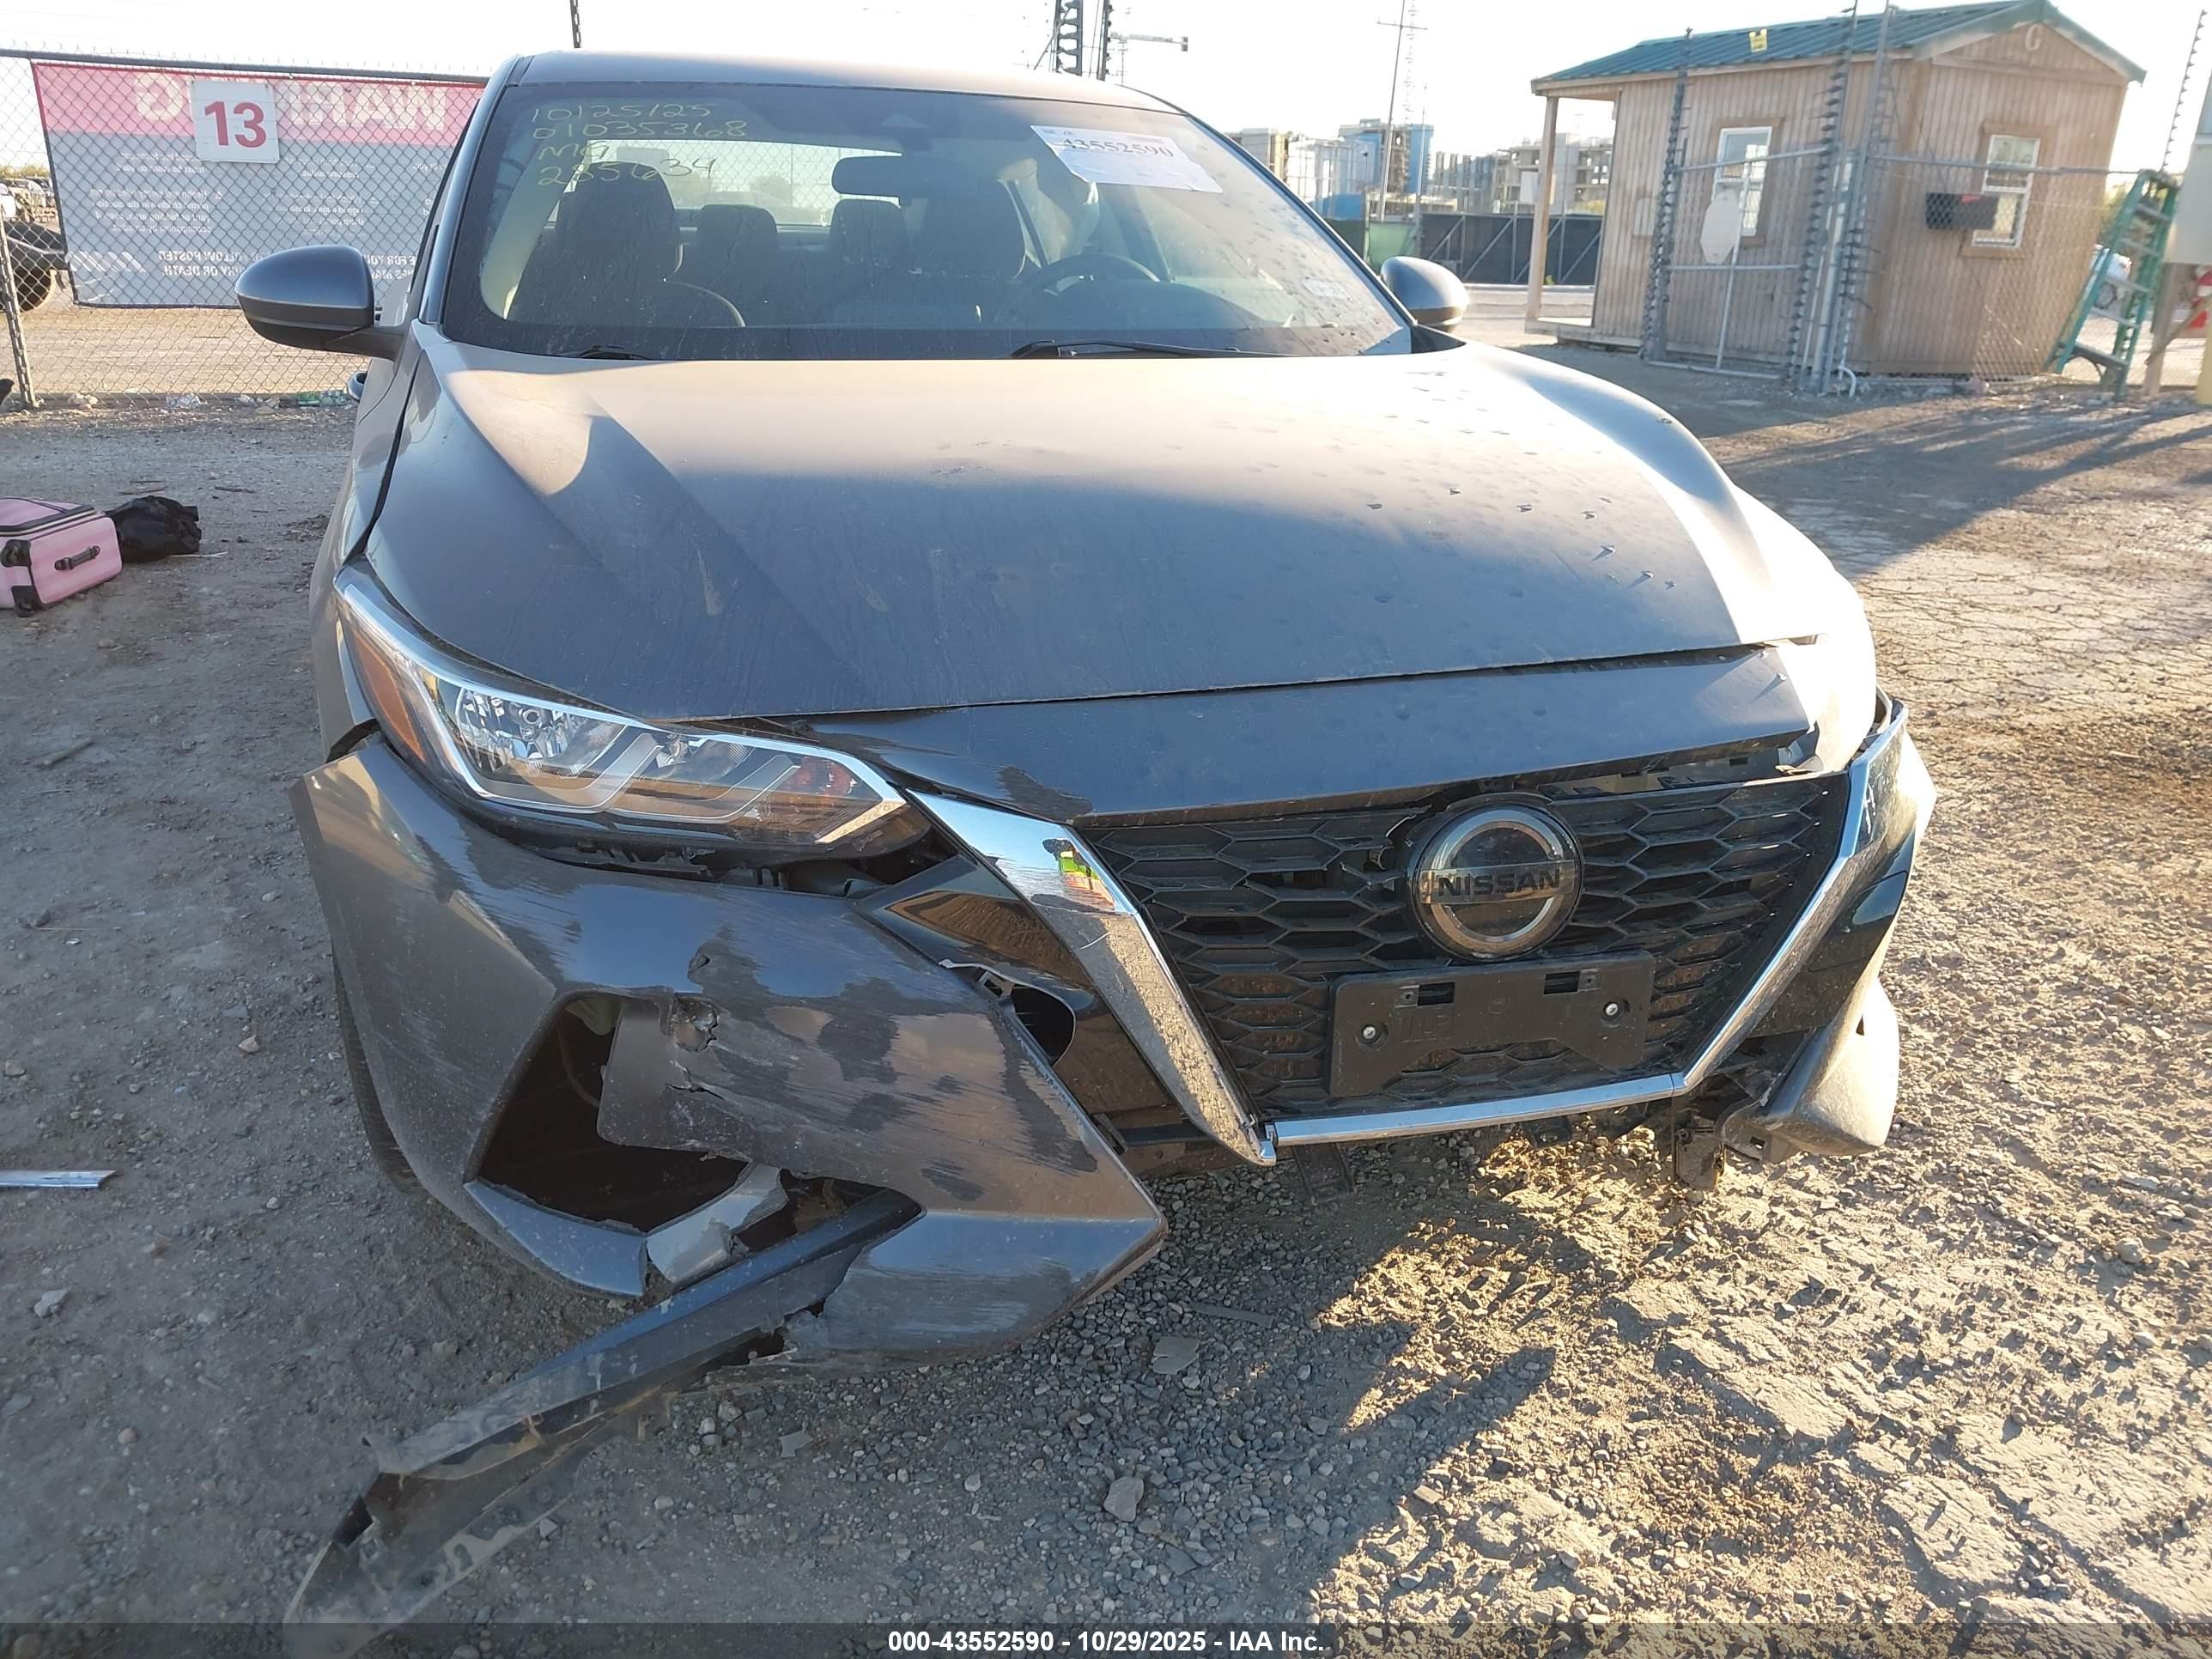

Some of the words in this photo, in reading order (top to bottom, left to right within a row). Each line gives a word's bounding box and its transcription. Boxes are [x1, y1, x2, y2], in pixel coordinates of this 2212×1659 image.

[204, 100, 267, 149] 13
[1063, 138, 1175, 157] 43552590
[1438, 868, 1560, 896] NISSAN
